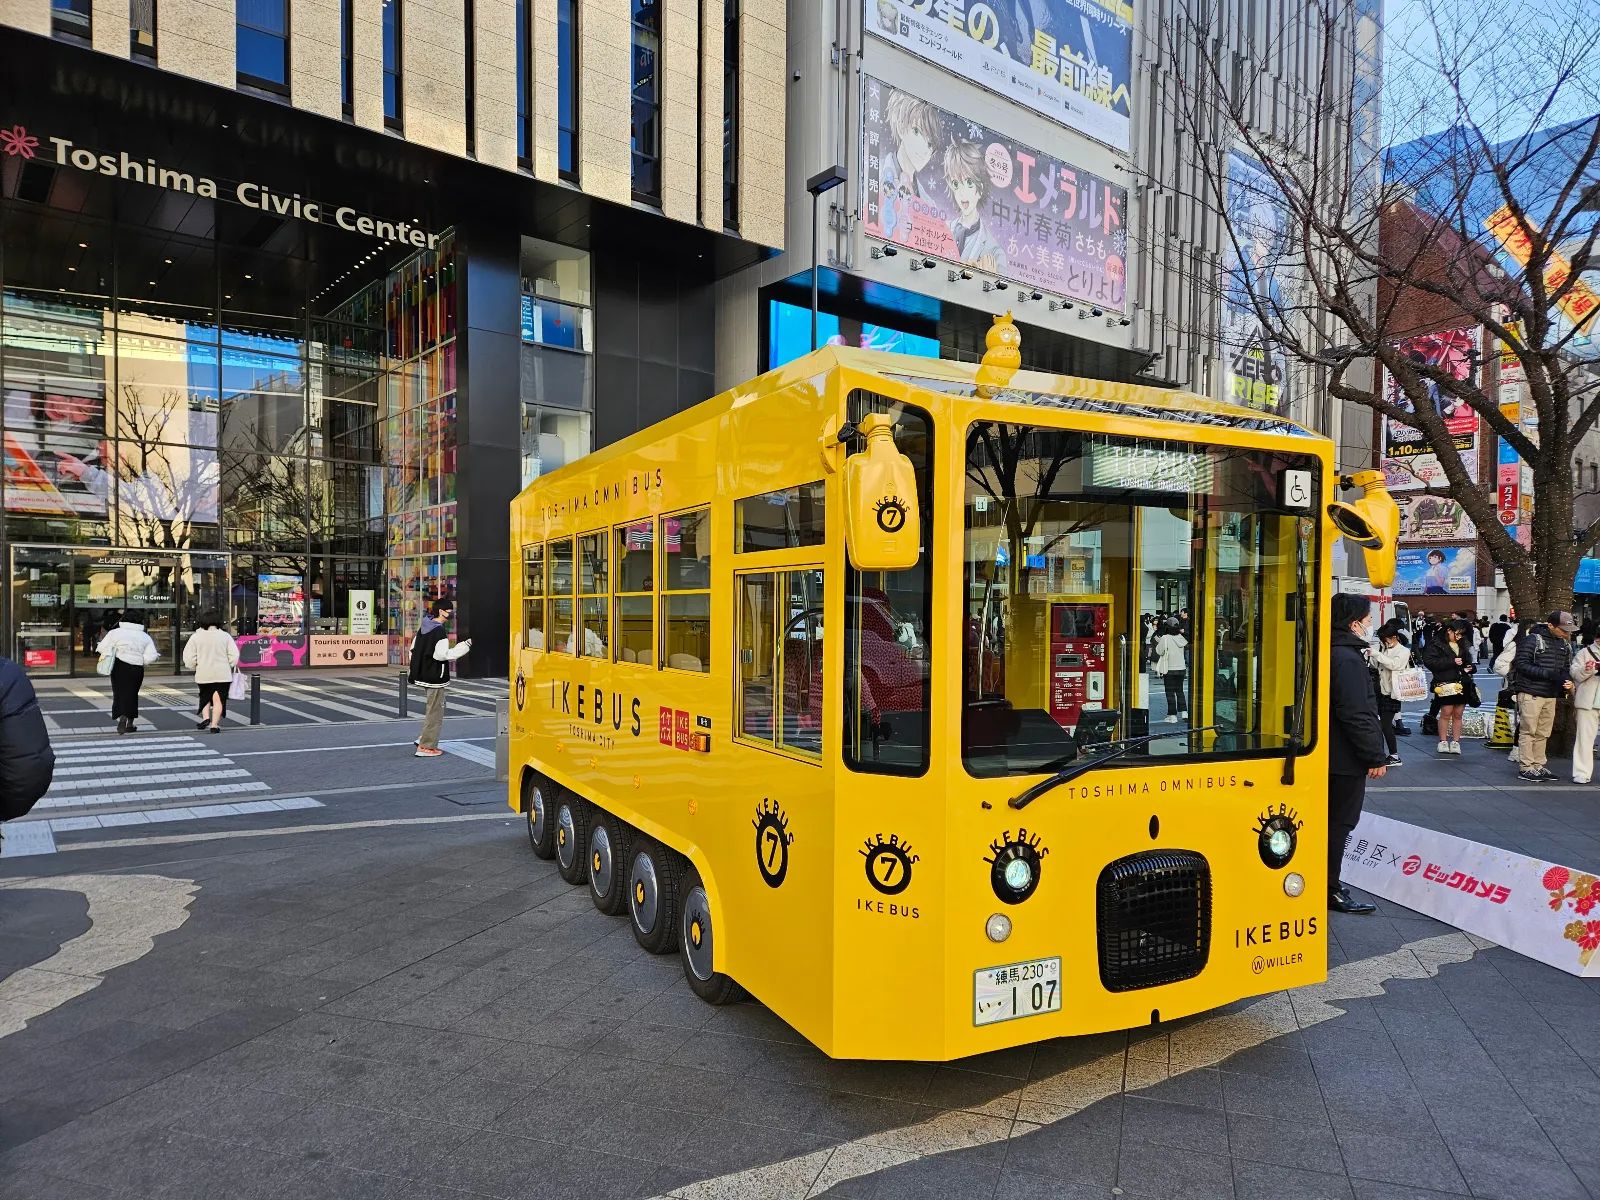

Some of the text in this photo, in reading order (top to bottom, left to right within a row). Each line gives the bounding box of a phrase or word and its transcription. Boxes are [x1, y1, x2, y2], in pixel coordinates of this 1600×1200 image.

[919, 34, 963, 61] エンドフィールド
[868, 85, 881, 216] 大好評発売中
[49, 136, 439, 250] Toshima Civic Center
[1013, 151, 1121, 236] エメラルド
[991, 200, 1072, 250] 中村春菊
[1075, 231, 1107, 260] さちも
[1067, 264, 1122, 304] とりよし
[871, 495, 911, 513] IKEBUS
[1503, 486, 1514, 510] ガスト
[886, 509, 898, 526] 7
[551, 678, 641, 737] IKEBUS
[660, 711, 672, 725] イケ
[569, 723, 596, 743] TOSHIMA
[660, 726, 672, 741] バス
[676, 715, 688, 729] IKE
[676, 731, 688, 745] BUS
[1069, 775, 1237, 799] TOSHIMA OMNIBUS
[751, 797, 794, 846] IKEBUS
[1251, 802, 1304, 835] IKEBUS
[766, 831, 778, 868] 7
[858, 833, 920, 866] IKEBUS
[983, 827, 1049, 865] IKEBUS
[880, 856, 898, 882] 7
[1343, 852, 1379, 869] HIMA CITY
[1422, 863, 1512, 905] ビックカメラ
[857, 898, 920, 919] IKEBUS
[1235, 917, 1317, 948] IKEBUS
[995, 963, 1044, 986] 練馬 230
[1266, 953, 1303, 969] WILLER
